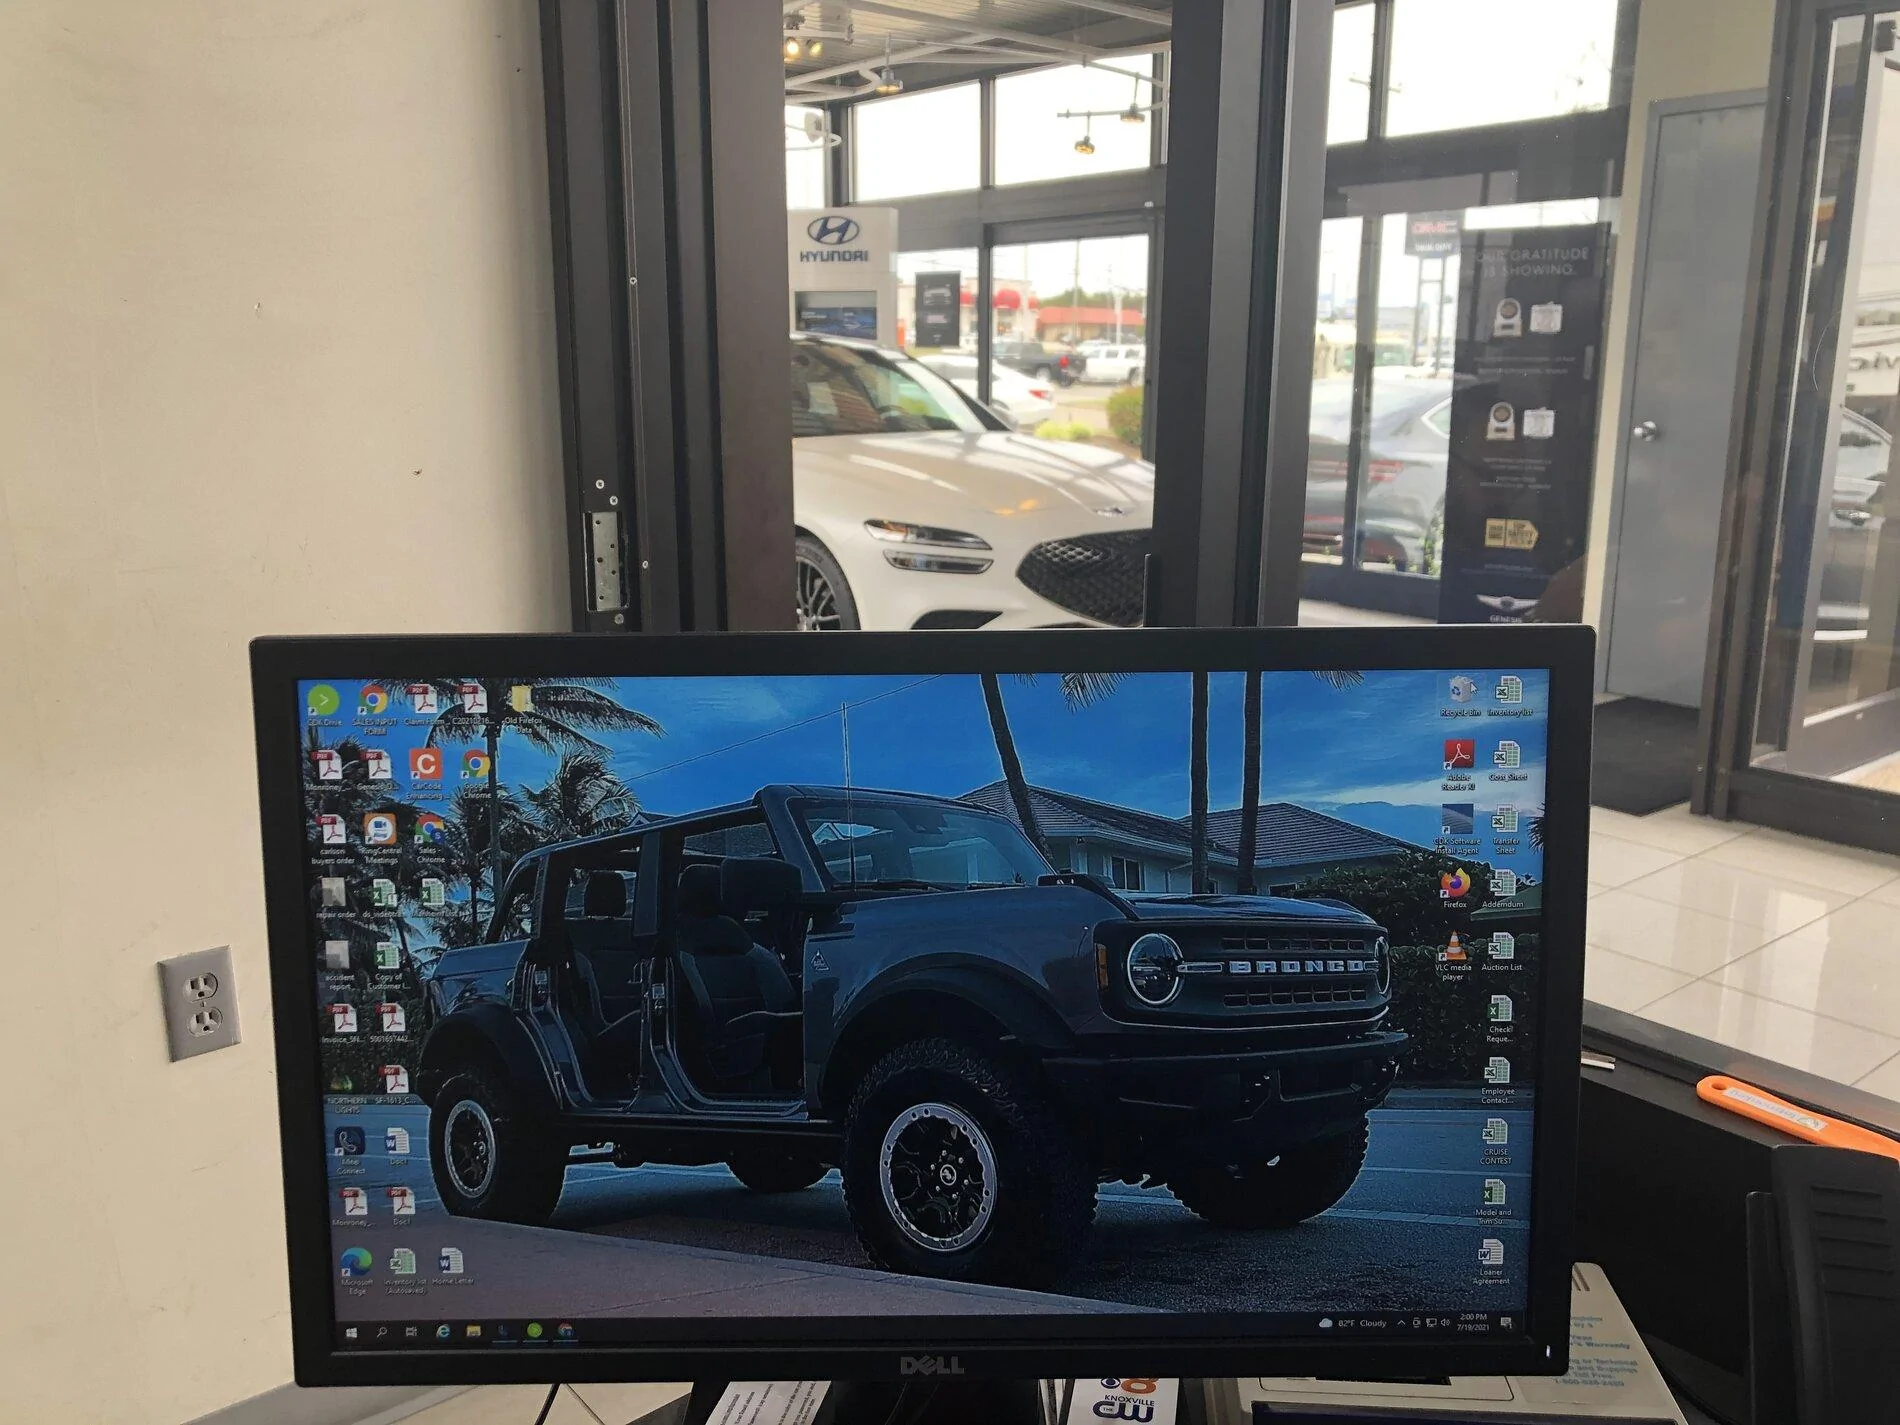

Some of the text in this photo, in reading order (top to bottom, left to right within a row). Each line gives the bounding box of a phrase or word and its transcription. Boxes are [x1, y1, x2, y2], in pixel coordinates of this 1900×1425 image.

[800, 250, 868, 262] HYUNDAI
[1510, 247, 1589, 261] GRATITUDE
[1440, 709, 1467, 718] Recycle
[1487, 709, 1521, 718] Inventory
[463, 791, 492, 799] Chrome
[1458, 847, 1479, 856] Agent
[1229, 960, 1364, 974] BRONCO
[1443, 974, 1464, 982] player
[1481, 1088, 1515, 1096] Employee
[1360, 1319, 1387, 1328] Cloudy
[901, 1355, 965, 1375] DELL
[1104, 1394, 1155, 1407] KNOXVILLE
